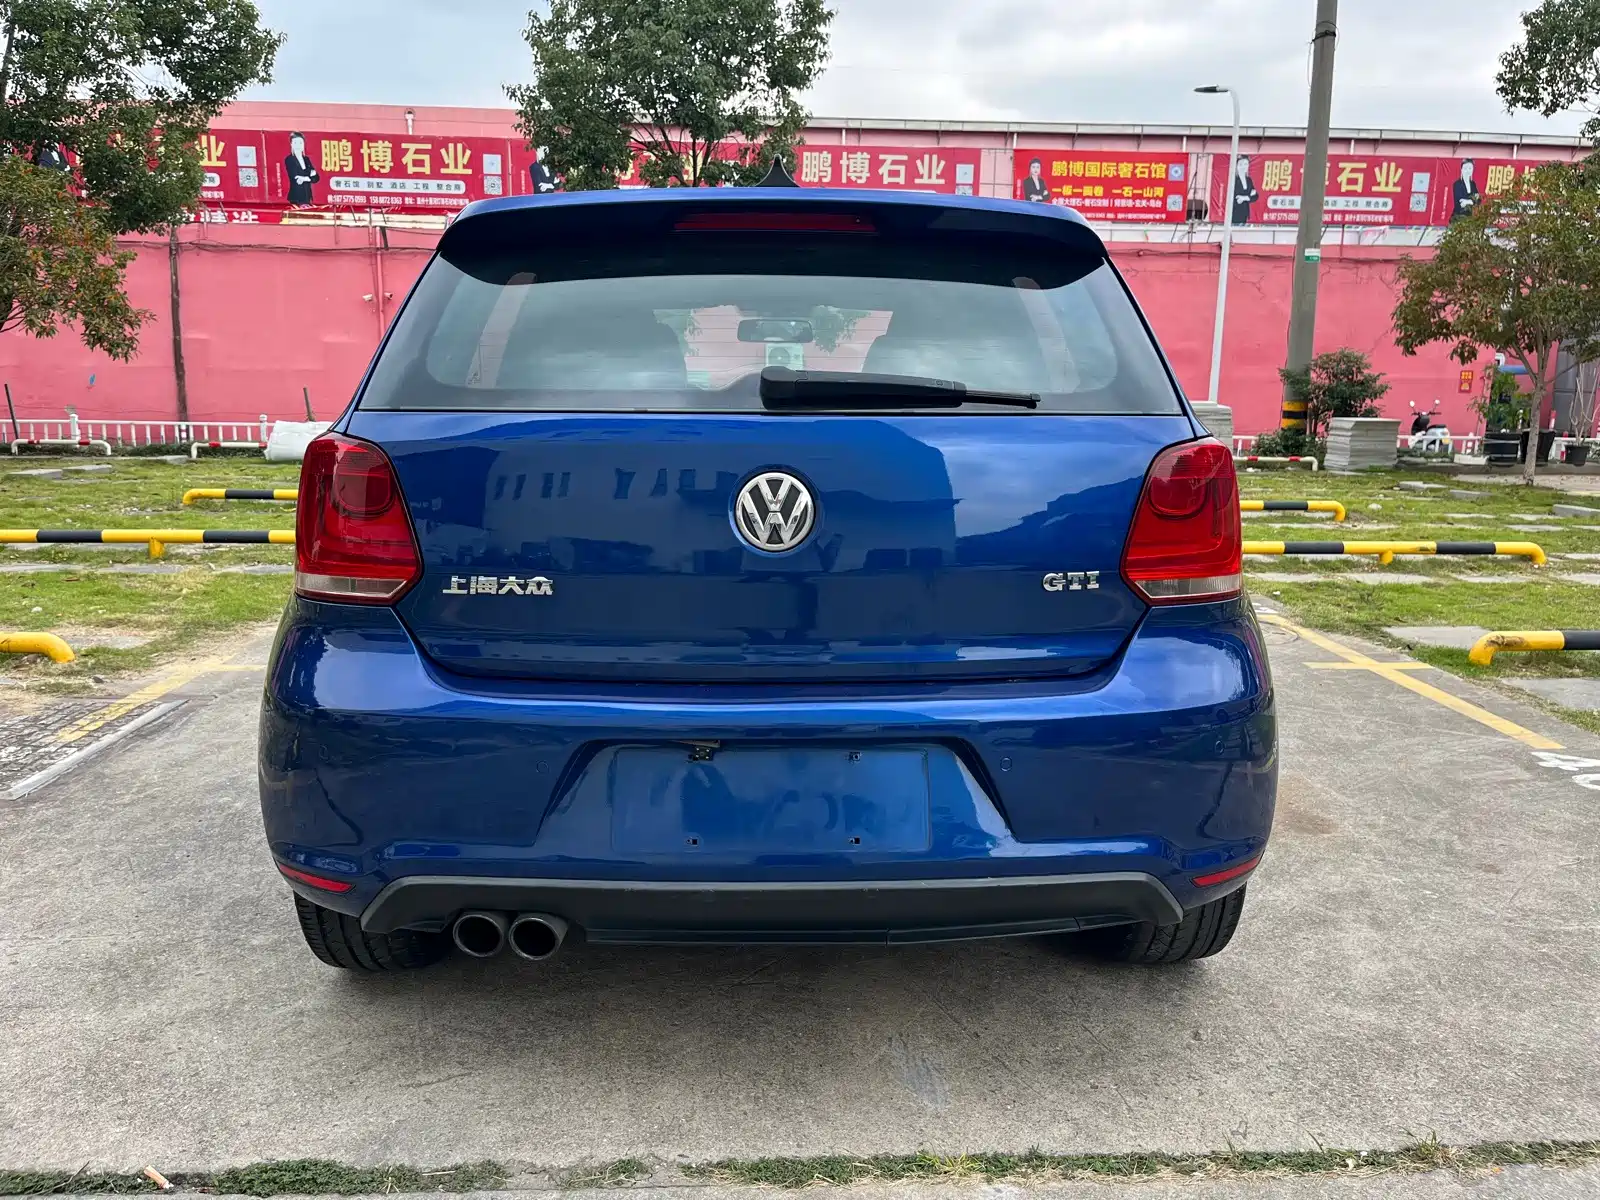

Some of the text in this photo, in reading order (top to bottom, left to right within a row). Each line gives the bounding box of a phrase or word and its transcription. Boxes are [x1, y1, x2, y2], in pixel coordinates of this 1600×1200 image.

[321, 139, 473, 175] 鹏博石业
[801, 151, 946, 185] 鹏博石业
[1051, 160, 1167, 179] 鹏博国际奢石馆
[1262, 159, 1403, 193] 鹏石业
[367, 181, 383, 189] 别墅
[390, 181, 407, 190] 酒店
[413, 182, 430, 190] 工程
[436, 183, 462, 191] 整合商
[1111, 186, 1164, 198] 一石一山河
[442, 575, 554, 596] 上海大众
[1043, 570, 1100, 592] GTI
